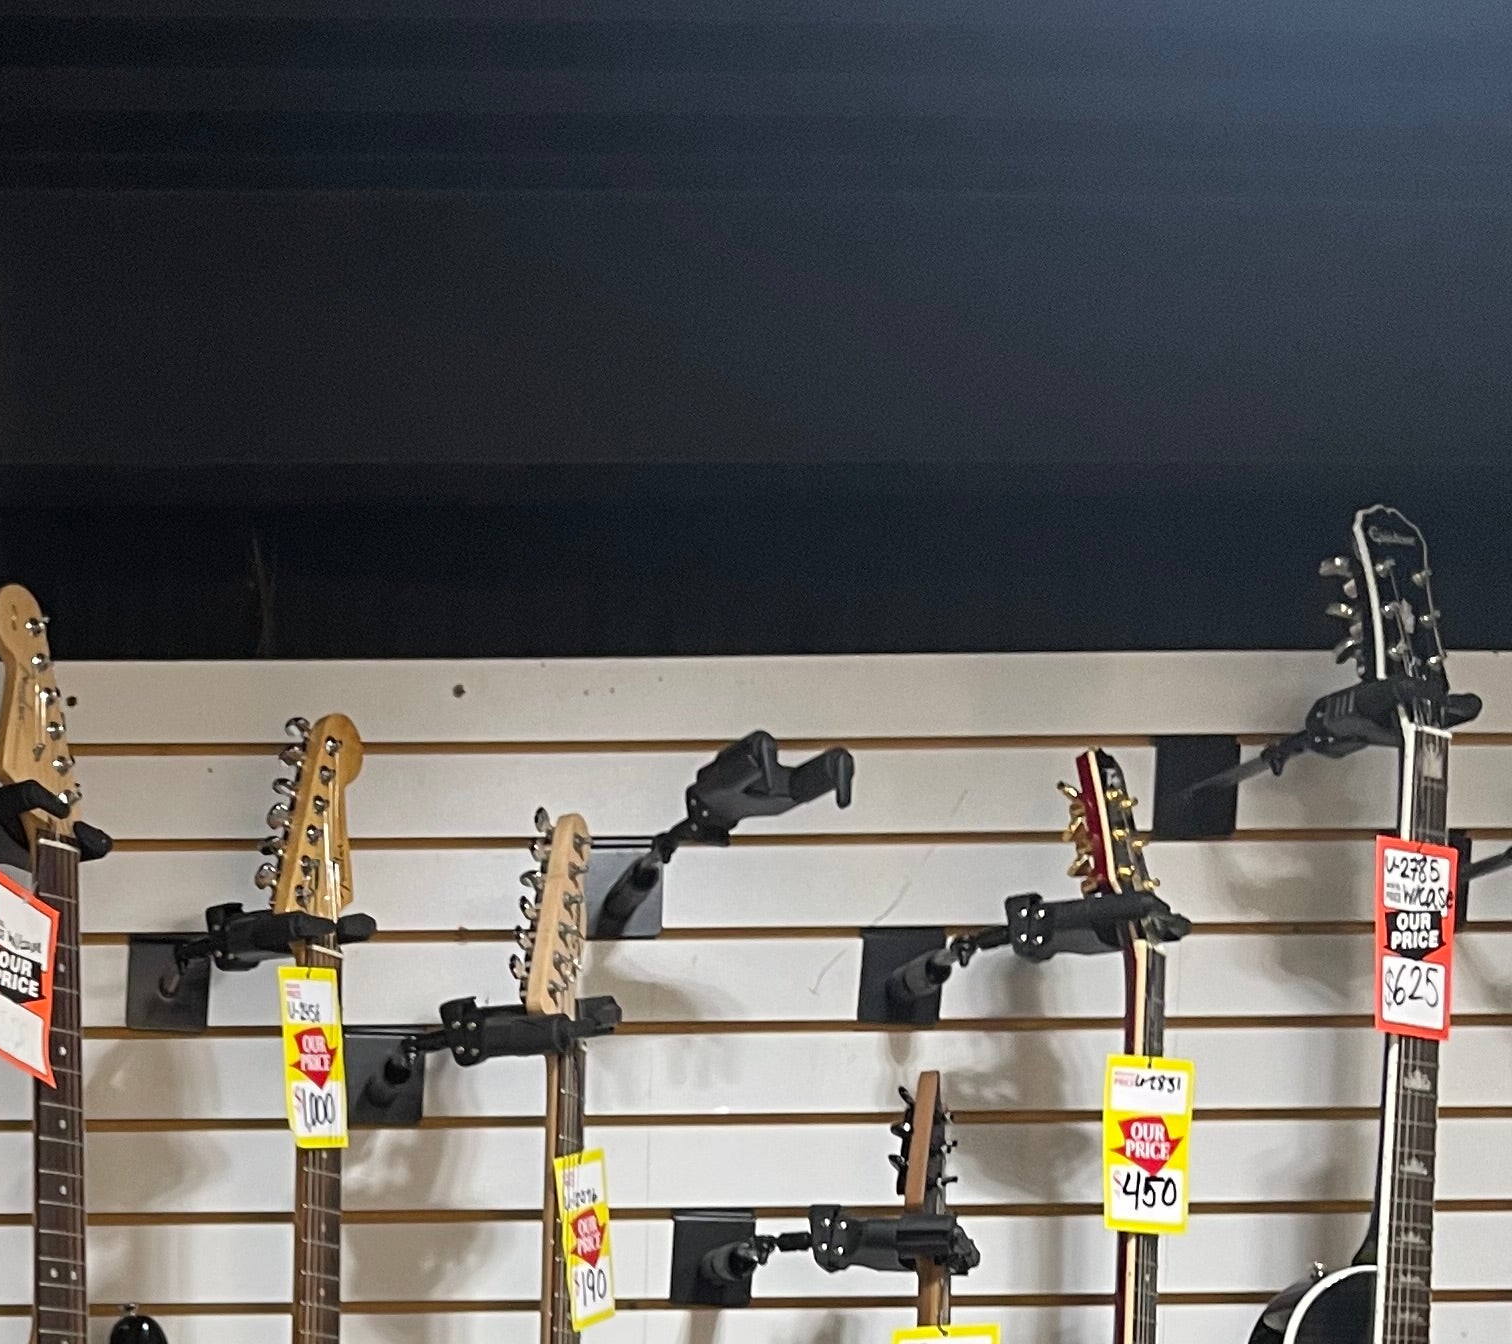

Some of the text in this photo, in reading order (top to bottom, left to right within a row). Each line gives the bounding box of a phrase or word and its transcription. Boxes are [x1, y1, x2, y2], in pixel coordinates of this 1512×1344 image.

[1395, 912, 1432, 931] OUR
[1390, 930, 1440, 950] PRICE
[1384, 963, 1439, 1012] $625
[300, 1034, 327, 1054] OUR
[299, 1052, 331, 1072] PRICE
[1129, 1121, 1166, 1143] OUR
[1124, 1139, 1171, 1161] PRICE
